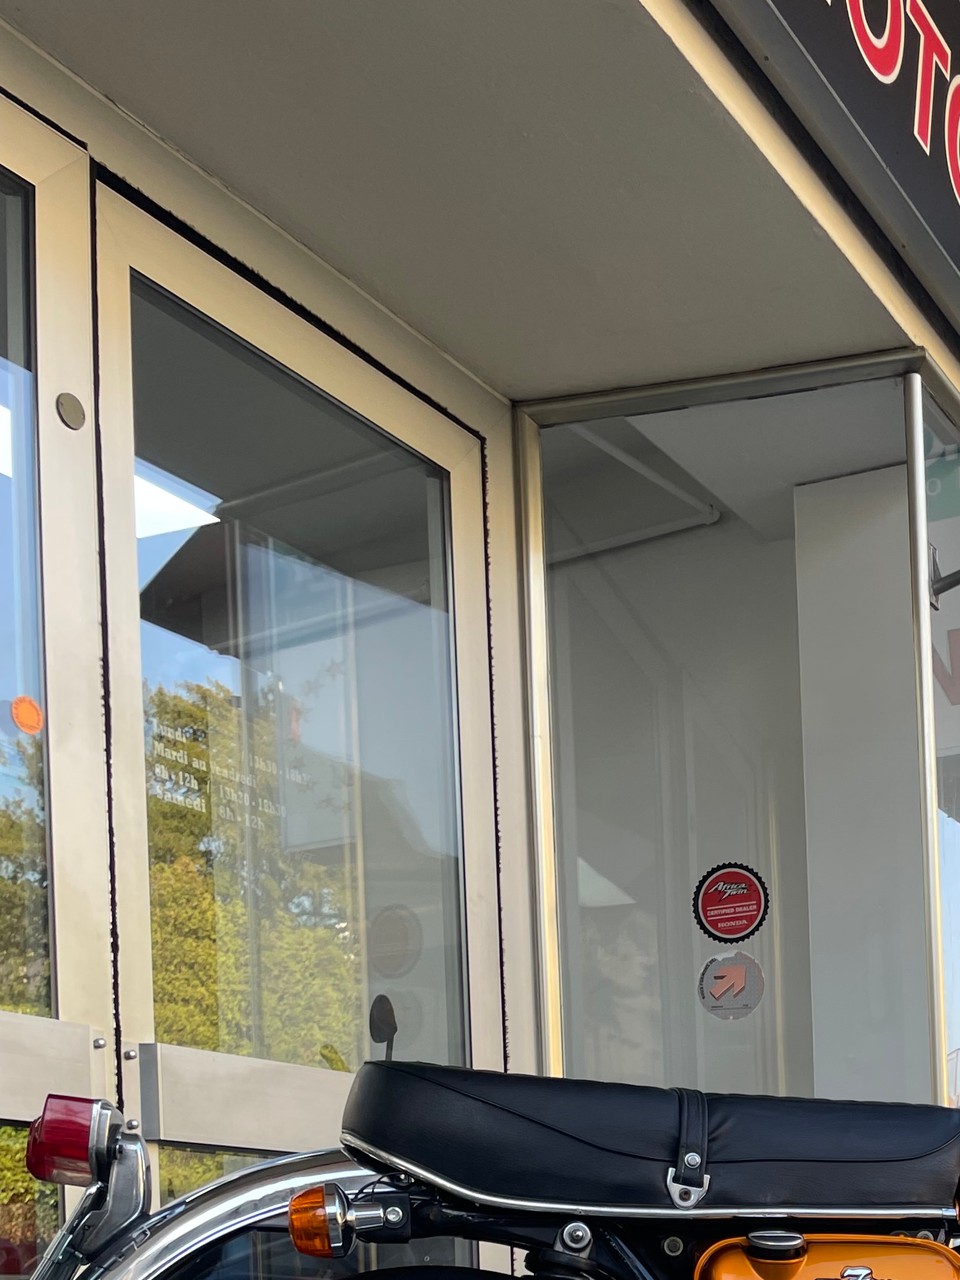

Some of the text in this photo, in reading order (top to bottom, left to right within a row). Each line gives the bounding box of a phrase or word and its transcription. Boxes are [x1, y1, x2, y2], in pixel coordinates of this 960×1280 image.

[153, 741, 257, 788] Mardi au Vendredi
[154, 763, 169, 780] 8h
[178, 771, 199, 790] 12h
[219, 784, 250, 806] 13h30
[258, 798, 287, 818] 18h30
[156, 784, 207, 813] Samedi
[218, 805, 235, 822] 8h
[244, 813, 265, 832] 12h
[708, 881, 748, 894] Africa
[721, 888, 750, 901] Twin
[707, 904, 757, 917] CERTIFIED DEALER
[717, 919, 748, 929] HONDA
